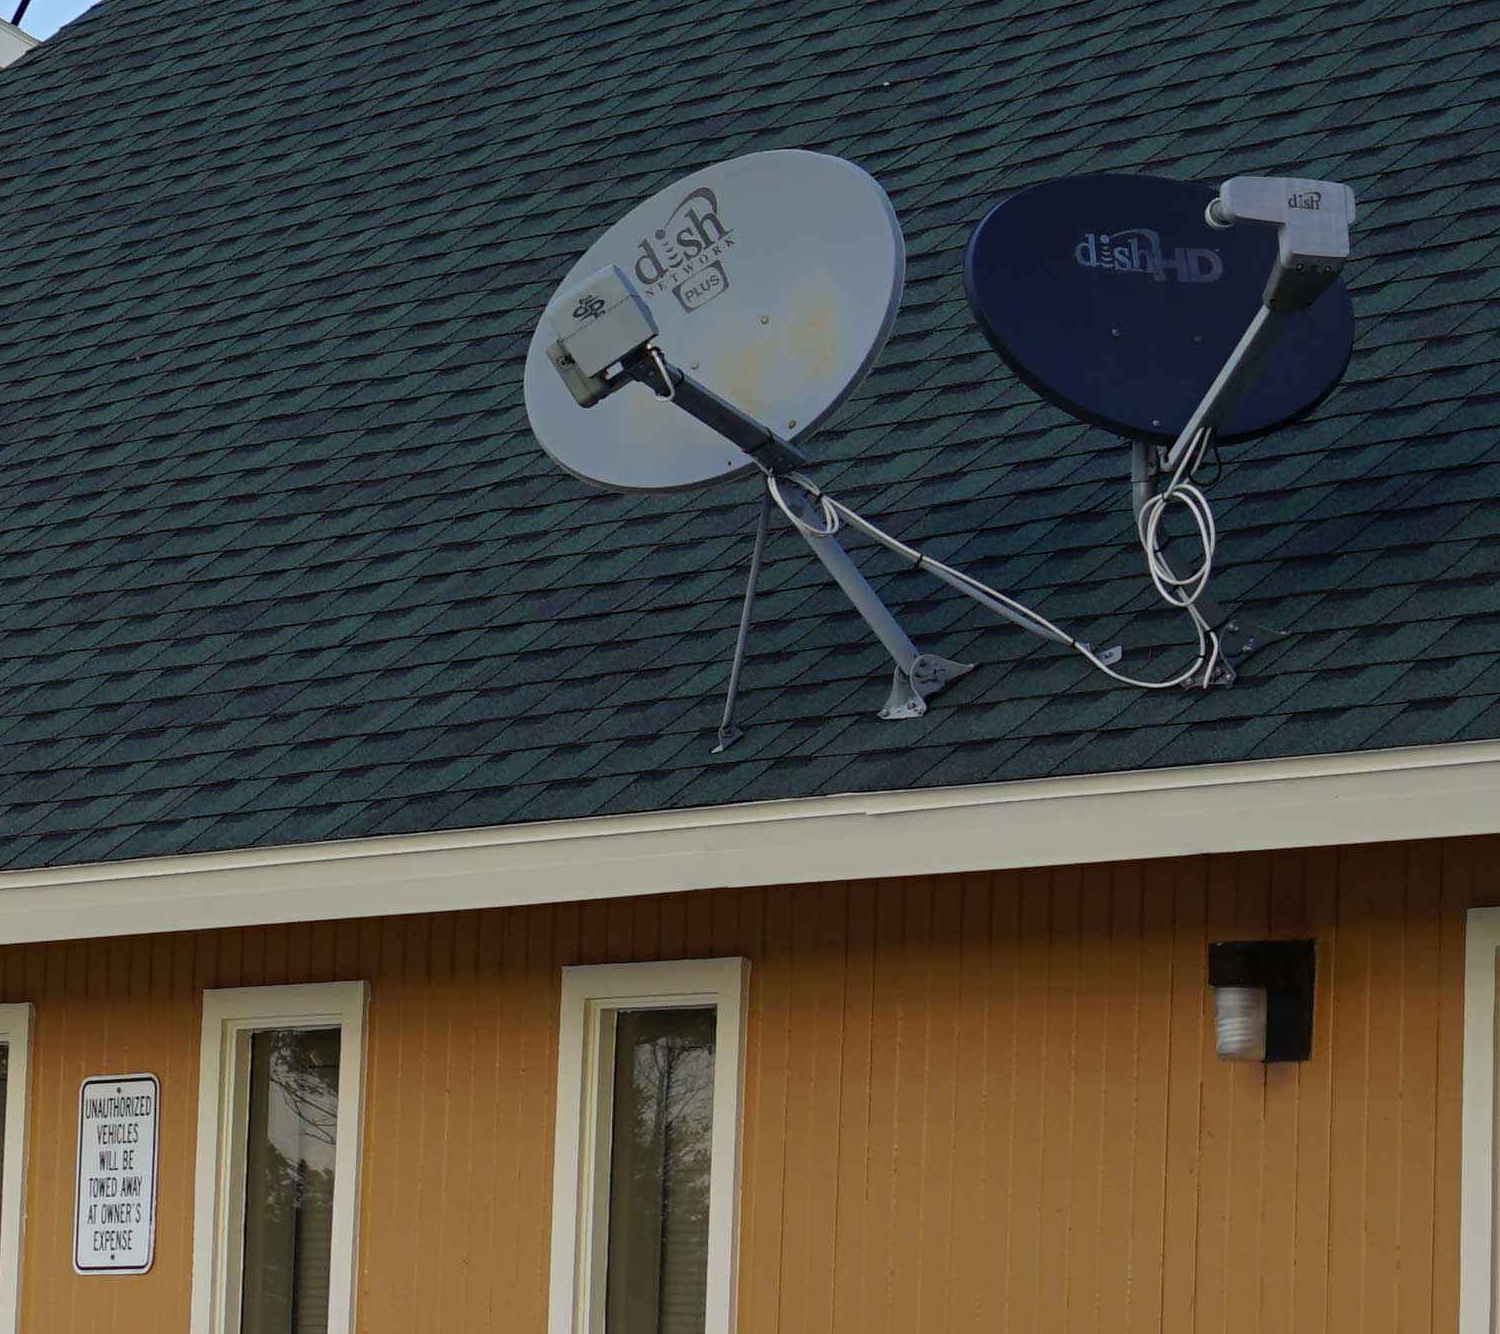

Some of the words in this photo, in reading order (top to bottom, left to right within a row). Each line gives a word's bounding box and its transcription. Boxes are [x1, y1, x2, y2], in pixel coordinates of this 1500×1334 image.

[1287, 192, 1322, 211] dish
[634, 189, 733, 286] dish
[644, 235, 737, 298] NETWORK
[684, 273, 721, 304] PLUS
[85, 1096, 151, 1119] UNAUTHORIZED
[97, 1123, 139, 1145] VEHICLES
[99, 1151, 118, 1171] WILL
[123, 1150, 134, 1170] BE
[89, 1177, 117, 1198] TOWED
[120, 1176, 143, 1197] AWAY
[87, 1204, 98, 1224] AT
[101, 1203, 141, 1224] OWNER'S
[93, 1230, 133, 1252] EXPENSE
